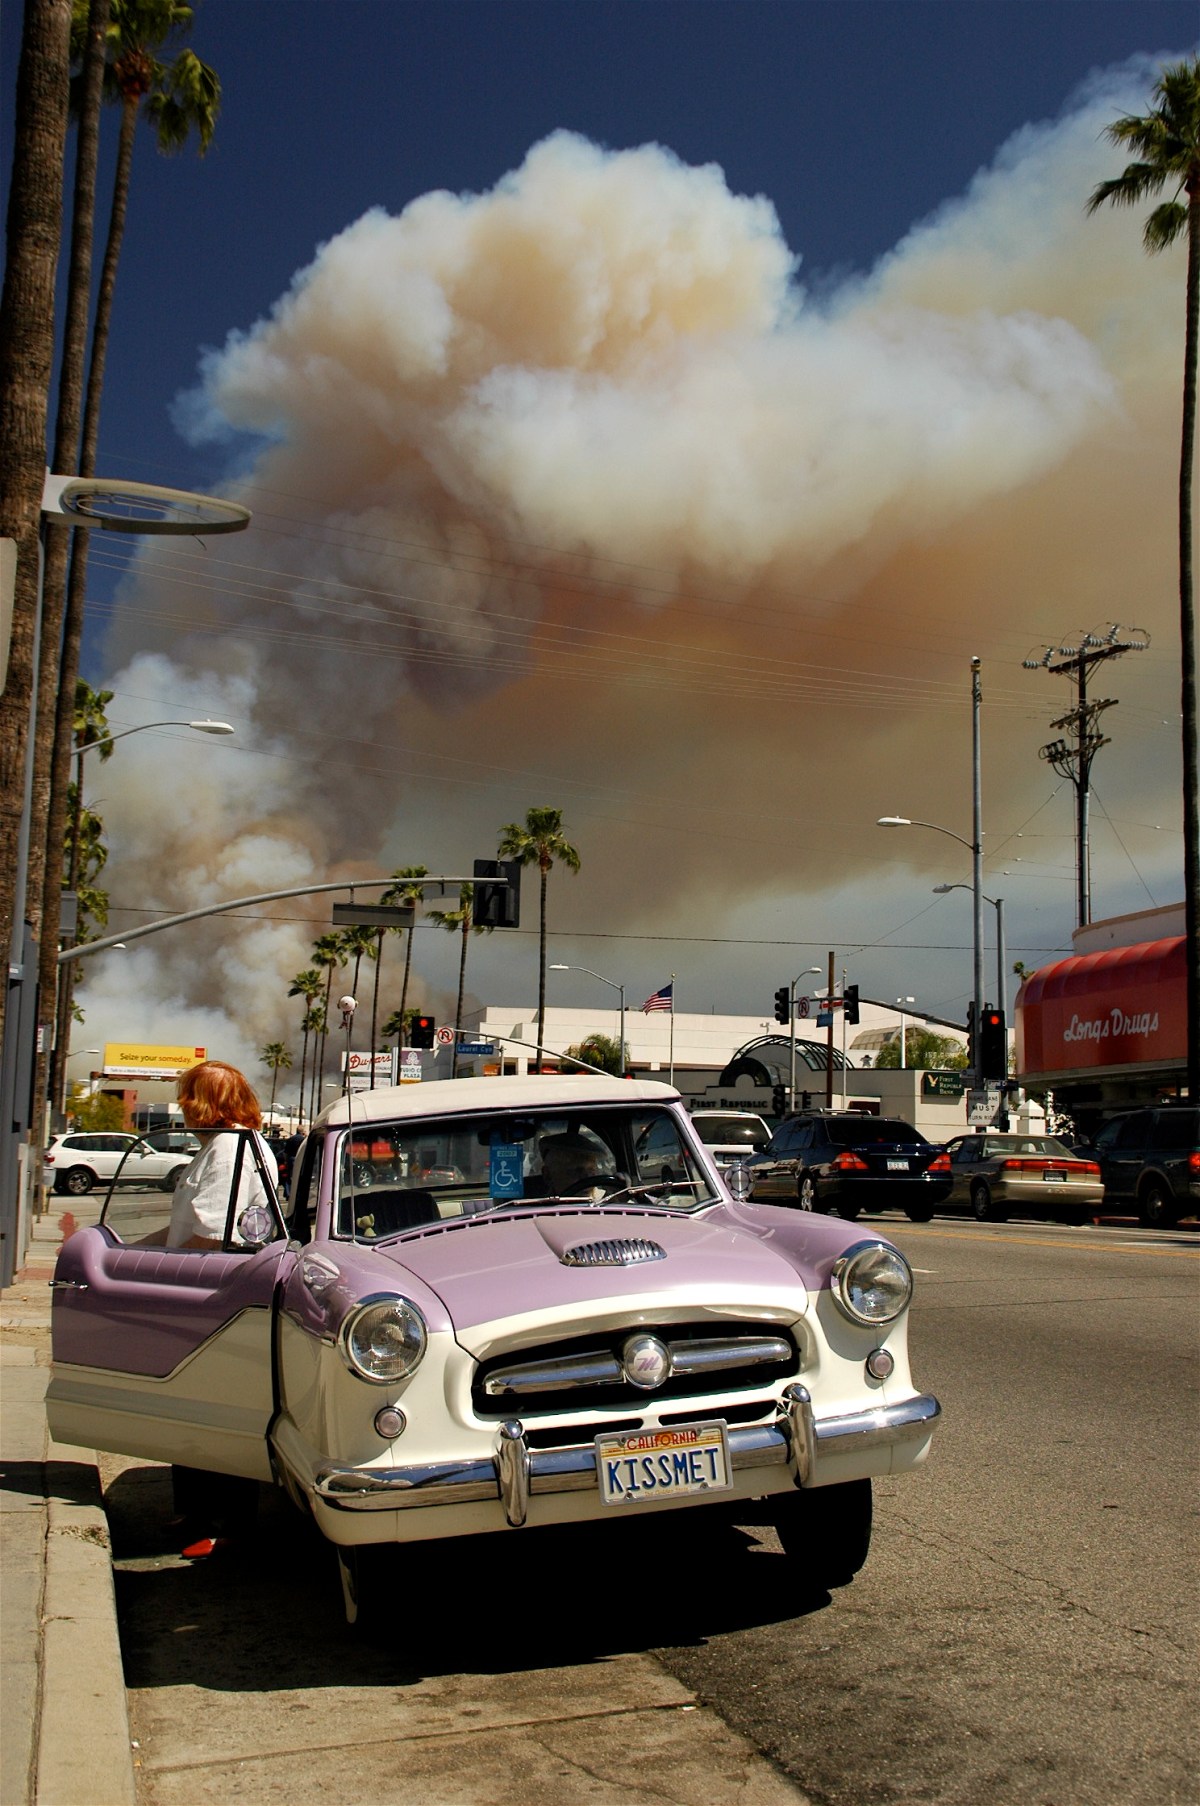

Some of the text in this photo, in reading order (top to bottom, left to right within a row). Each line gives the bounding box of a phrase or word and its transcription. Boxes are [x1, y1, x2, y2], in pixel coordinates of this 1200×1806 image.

[1063, 1008, 1159, 1042] Longs Drugs
[140, 1055, 157, 1063] your
[159, 1056, 192, 1064] someday.
[690, 1098, 768, 1108] FIRST REPUBLIC
[627, 1431, 697, 1450] CALIFORNIA
[607, 1448, 718, 1493] KISSMET
